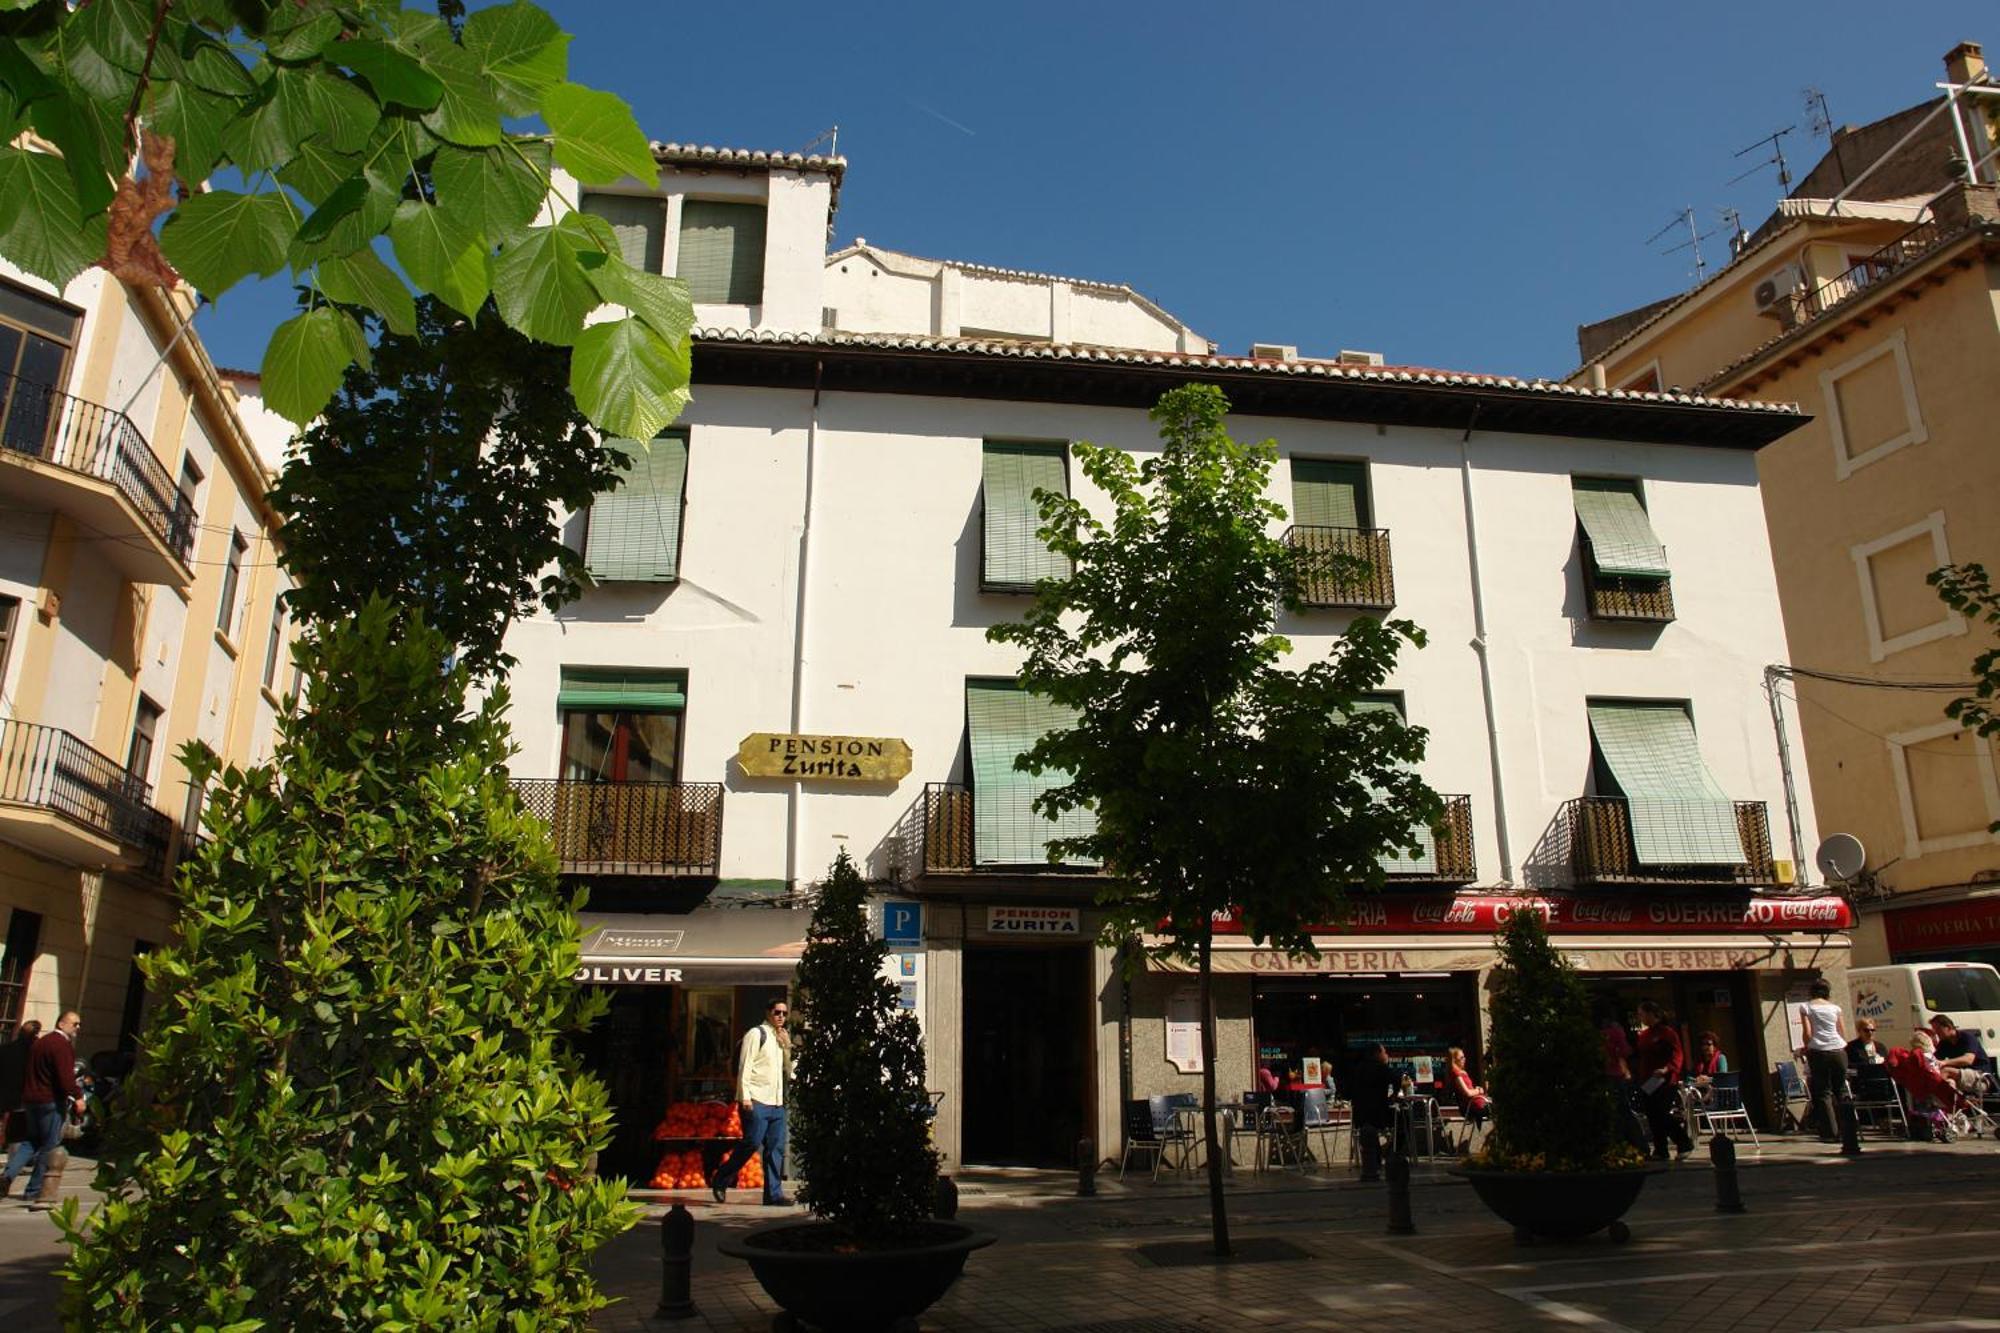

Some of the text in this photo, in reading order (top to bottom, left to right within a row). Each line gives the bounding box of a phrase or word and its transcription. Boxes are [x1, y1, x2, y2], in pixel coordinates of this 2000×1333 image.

[783, 755, 862, 776] Zurita
[895, 910, 910, 931] P
[995, 909, 1072, 919] PENSION
[1649, 902, 1775, 924] GUERRERO
[991, 919, 1076, 932] ZURITA
[574, 967, 683, 982] OLIVER
